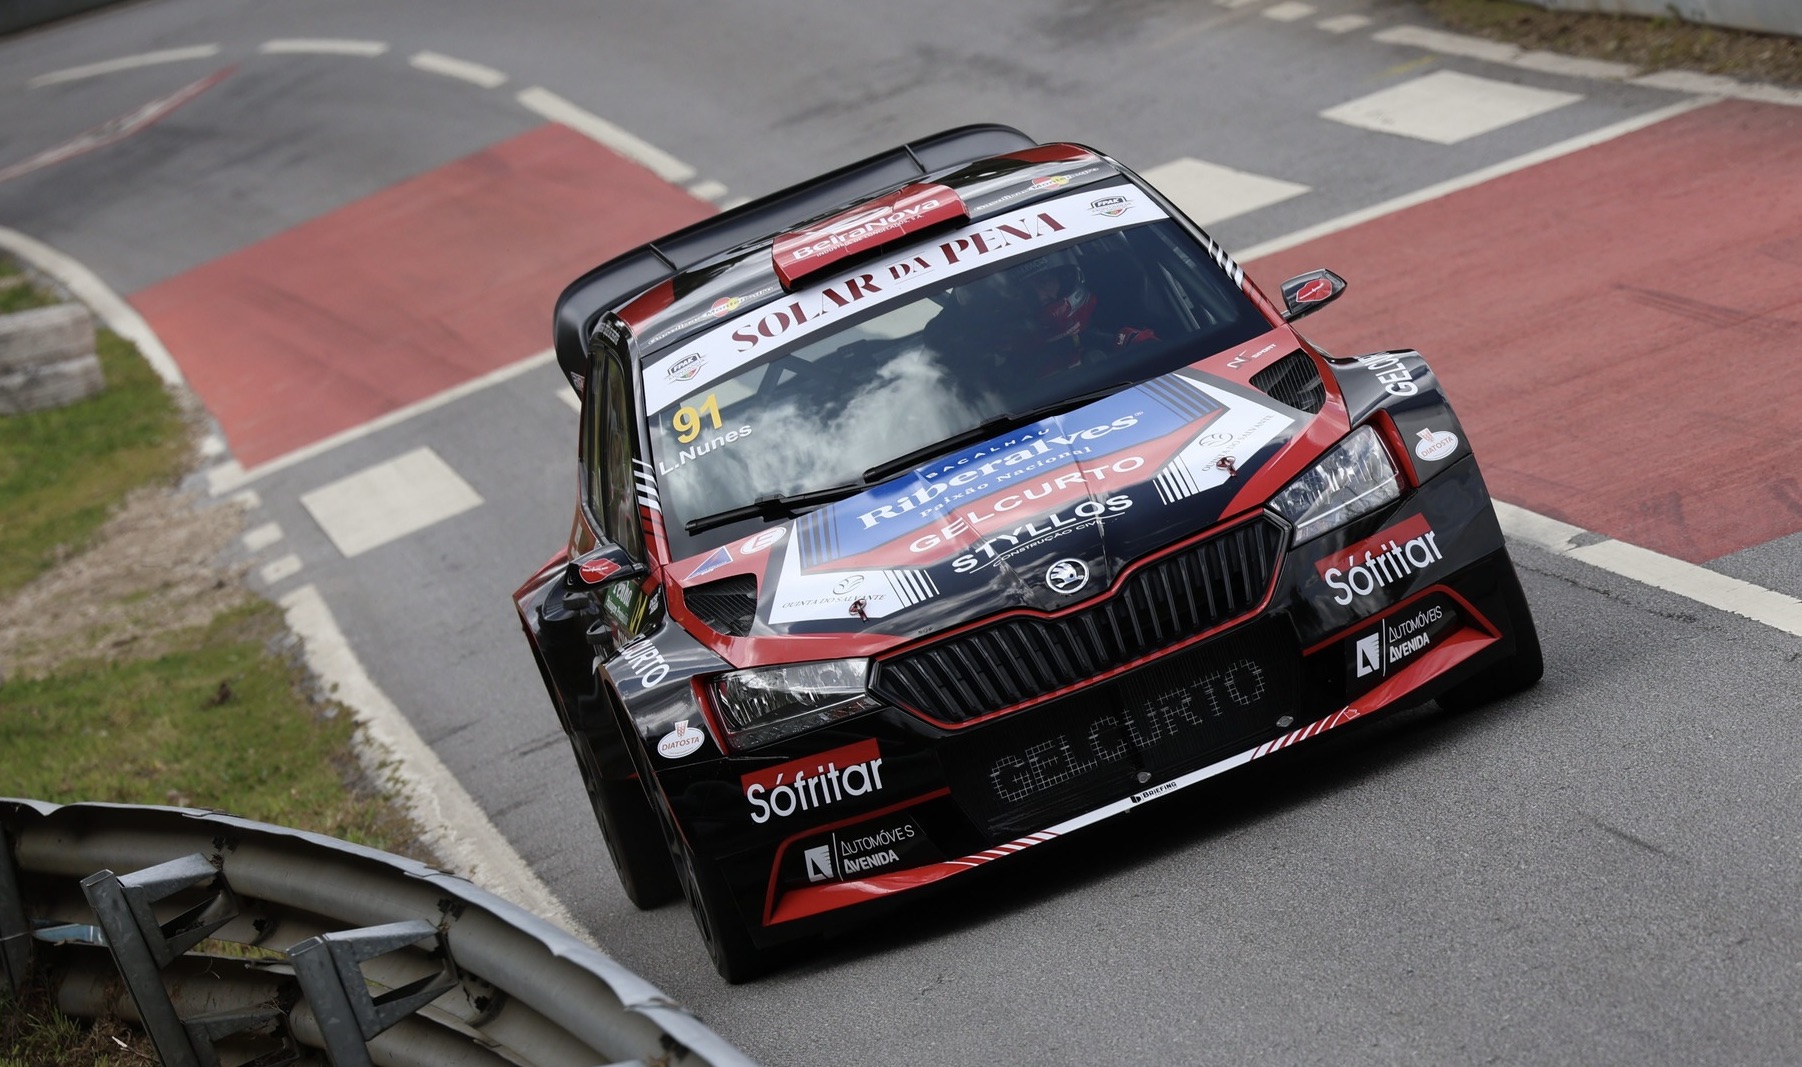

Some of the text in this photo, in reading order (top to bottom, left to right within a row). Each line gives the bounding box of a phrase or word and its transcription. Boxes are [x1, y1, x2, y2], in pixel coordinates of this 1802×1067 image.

[731, 273, 883, 353] SOLAR
[888, 256, 932, 281] DA
[938, 212, 1067, 266] PENA
[673, 356, 694, 372] FPAK
[672, 393, 723, 444] 91
[856, 413, 1140, 530] Riberalves
[926, 428, 1050, 479] BACALHAU
[1421, 436, 1454, 457] DIATOSTA
[909, 456, 1146, 553] GELCURTO
[919, 446, 1093, 518] Paixão Nacional
[951, 495, 1134, 574] STYLLOS
[993, 528, 1073, 567] CONSTRUÇÃO
[1324, 530, 1443, 606] Sófritar
[1388, 605, 1443, 643] AUTOMÓVEIS
[1389, 631, 1431, 664] AVENIDA
[661, 736, 700, 751] DIATOSTA
[990, 659, 1266, 802] GELCURTO
[746, 757, 883, 824] Sófritar
[1142, 781, 1177, 799] BRIEFING
[843, 849, 900, 875] AVENIDA
